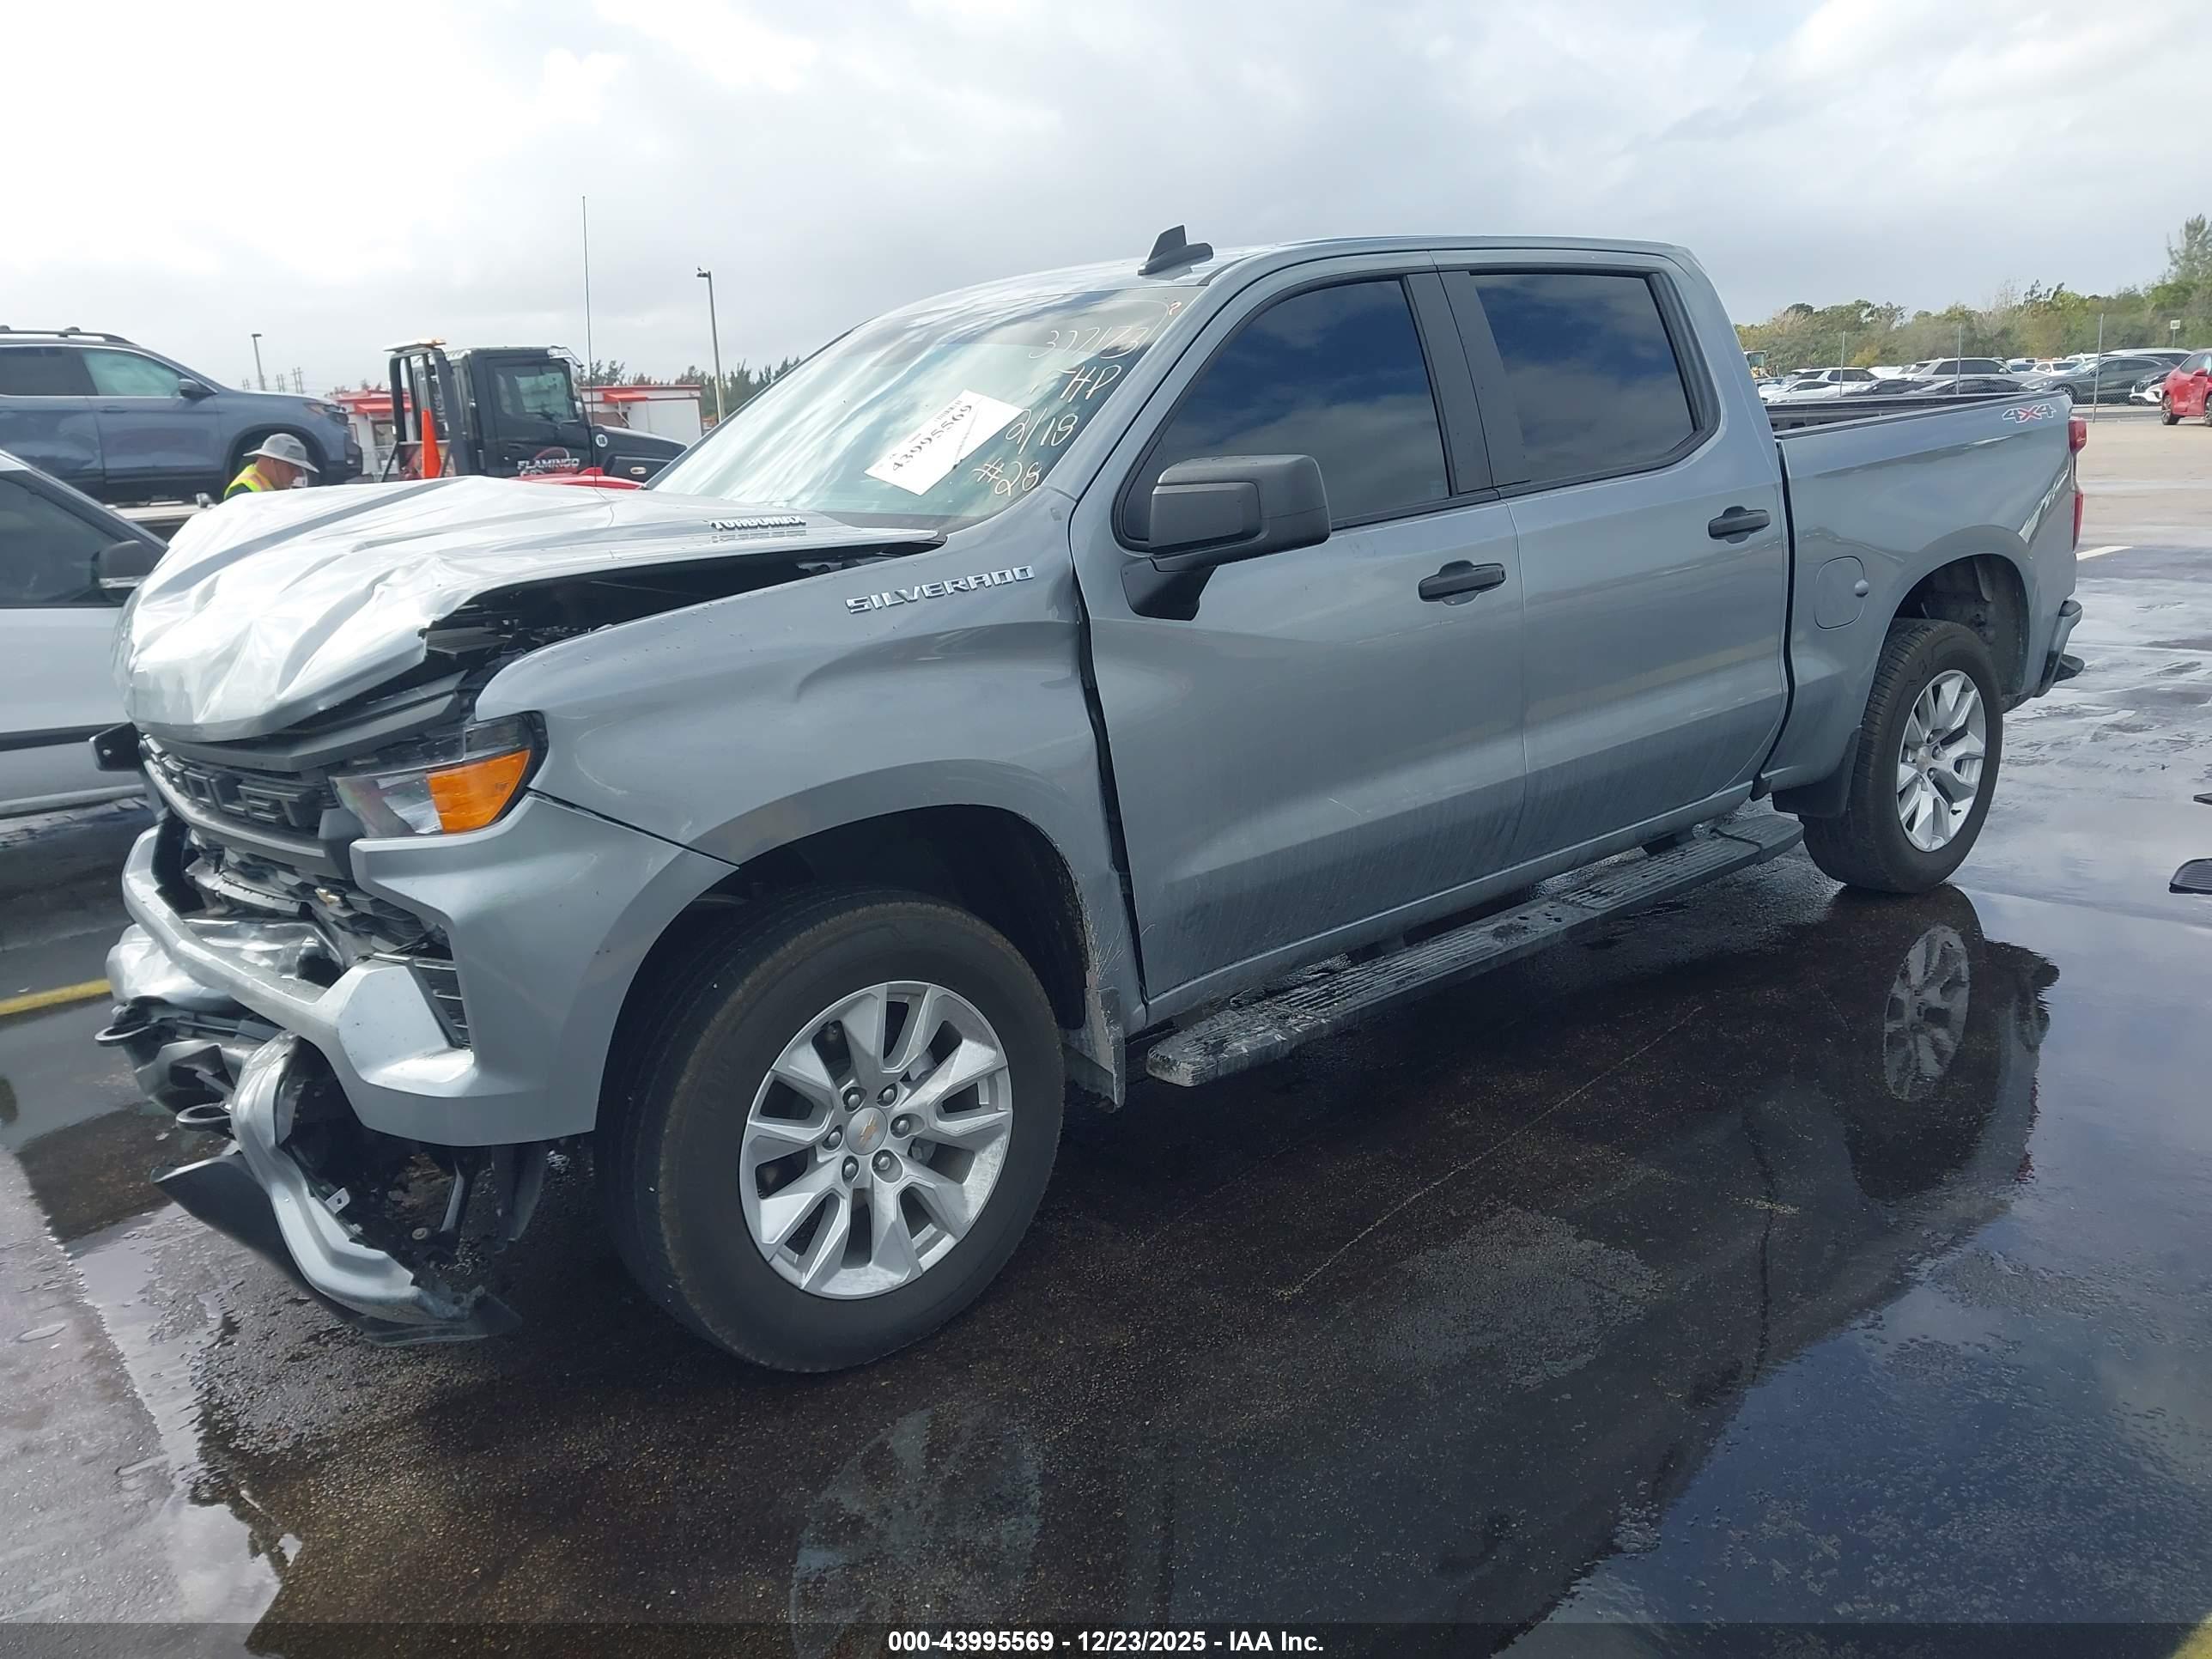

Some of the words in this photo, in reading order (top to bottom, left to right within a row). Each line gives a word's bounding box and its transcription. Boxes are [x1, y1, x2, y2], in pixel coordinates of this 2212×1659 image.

[892, 404, 972, 471] 43995569
[517, 458, 580, 471] FLAMINGO
[845, 565, 1036, 613] SILVERADO
